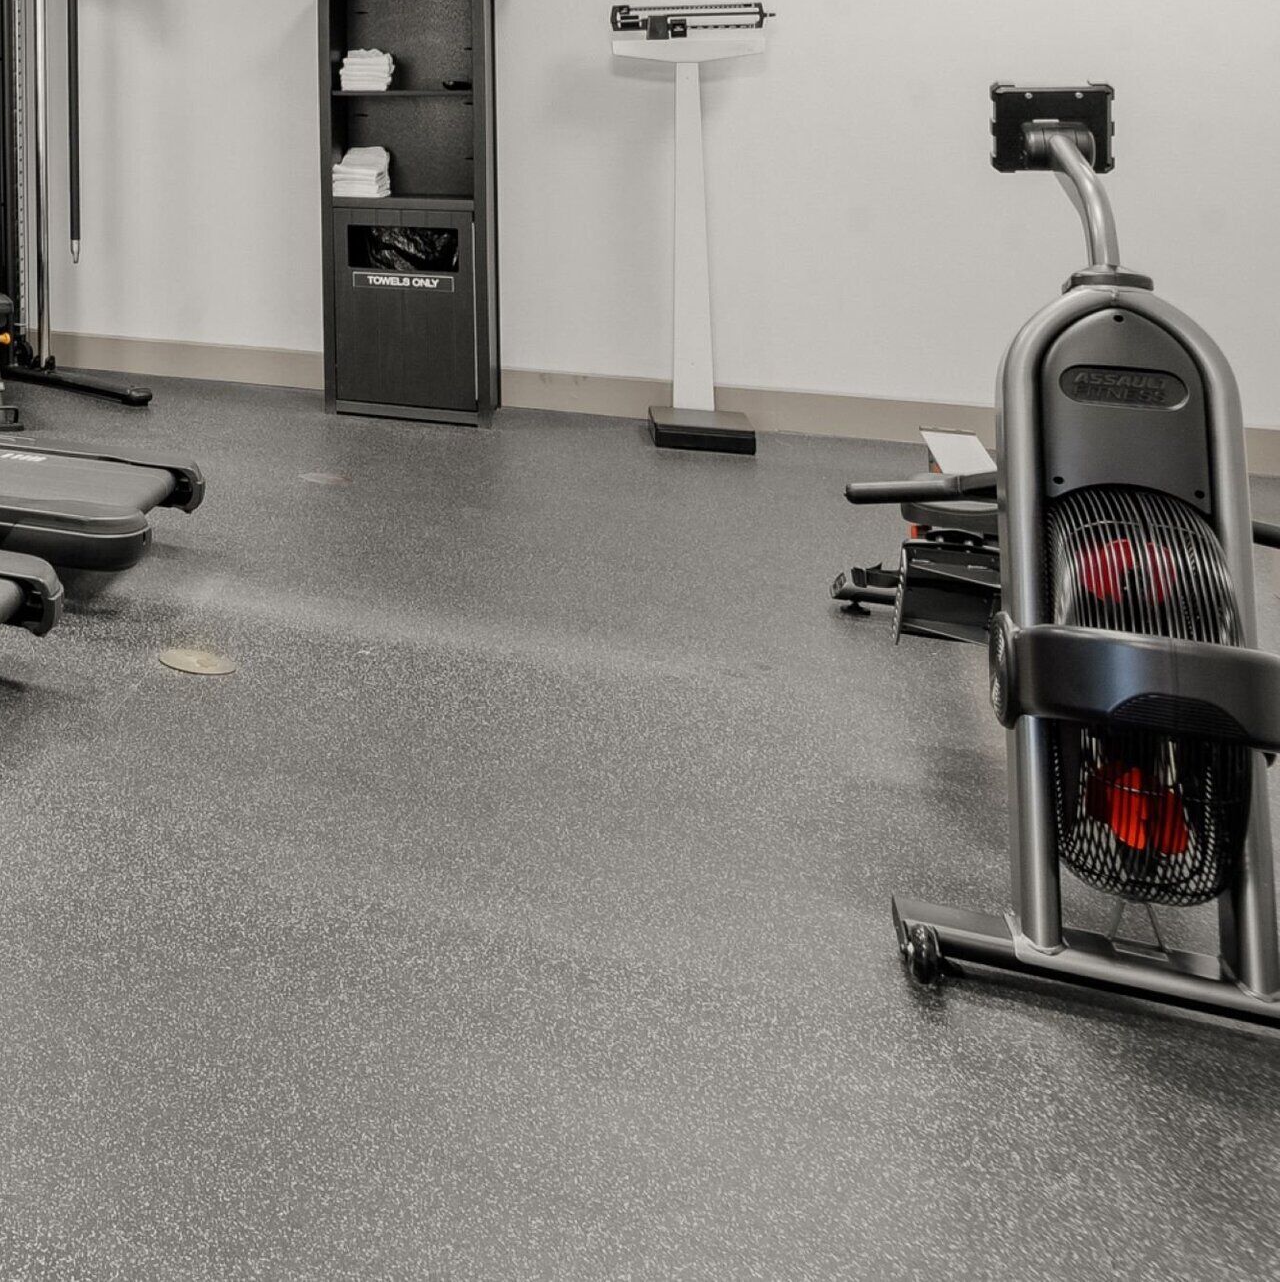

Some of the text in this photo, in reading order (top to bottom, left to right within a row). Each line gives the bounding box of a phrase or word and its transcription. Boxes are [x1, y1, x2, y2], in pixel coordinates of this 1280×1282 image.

[367, 275, 439, 288] TOWELS ONLY
[1073, 372, 1166, 389] ASSAULT
